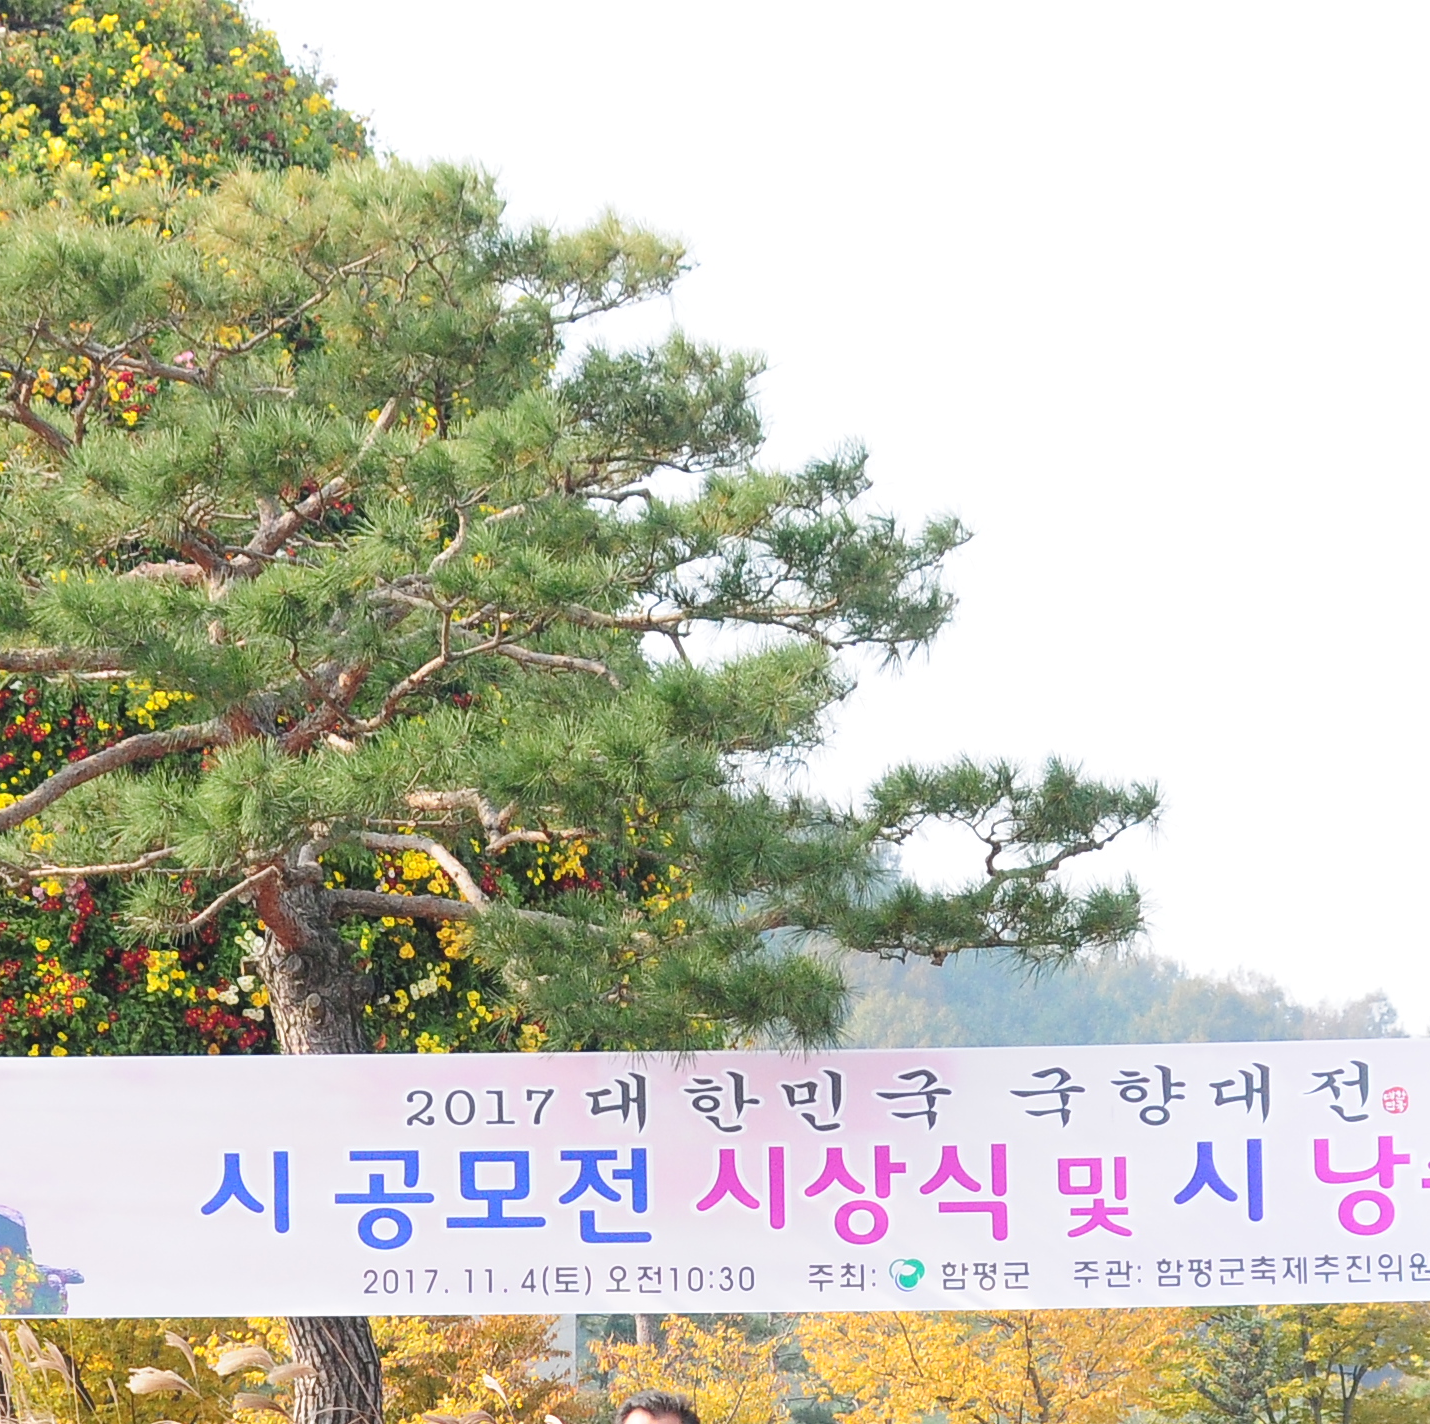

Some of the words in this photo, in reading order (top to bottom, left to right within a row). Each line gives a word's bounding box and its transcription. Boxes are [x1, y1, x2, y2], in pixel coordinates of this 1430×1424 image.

[407, 1089, 555, 1126] 2017
[585, 1065, 953, 1134] 대한민국
[1009, 1061, 1369, 1128] 국향대전
[200, 1150, 290, 1234] 시
[334, 1148, 653, 1251] 공모전
[695, 1143, 1009, 1245] 시상식
[1057, 1156, 1133, 1238] 및
[1174, 1138, 1264, 1222] 시
[363, 1268, 449, 1295] 2017.
[464, 1267, 508, 1294] 11.
[521, 1265, 592, 1296] 4(토)
[605, 1265, 755, 1293] 오전10:30
[808, 1263, 876, 1292] 주최:
[941, 1260, 1030, 1291] 함평군
[1073, 1259, 1142, 1289] 주관:
